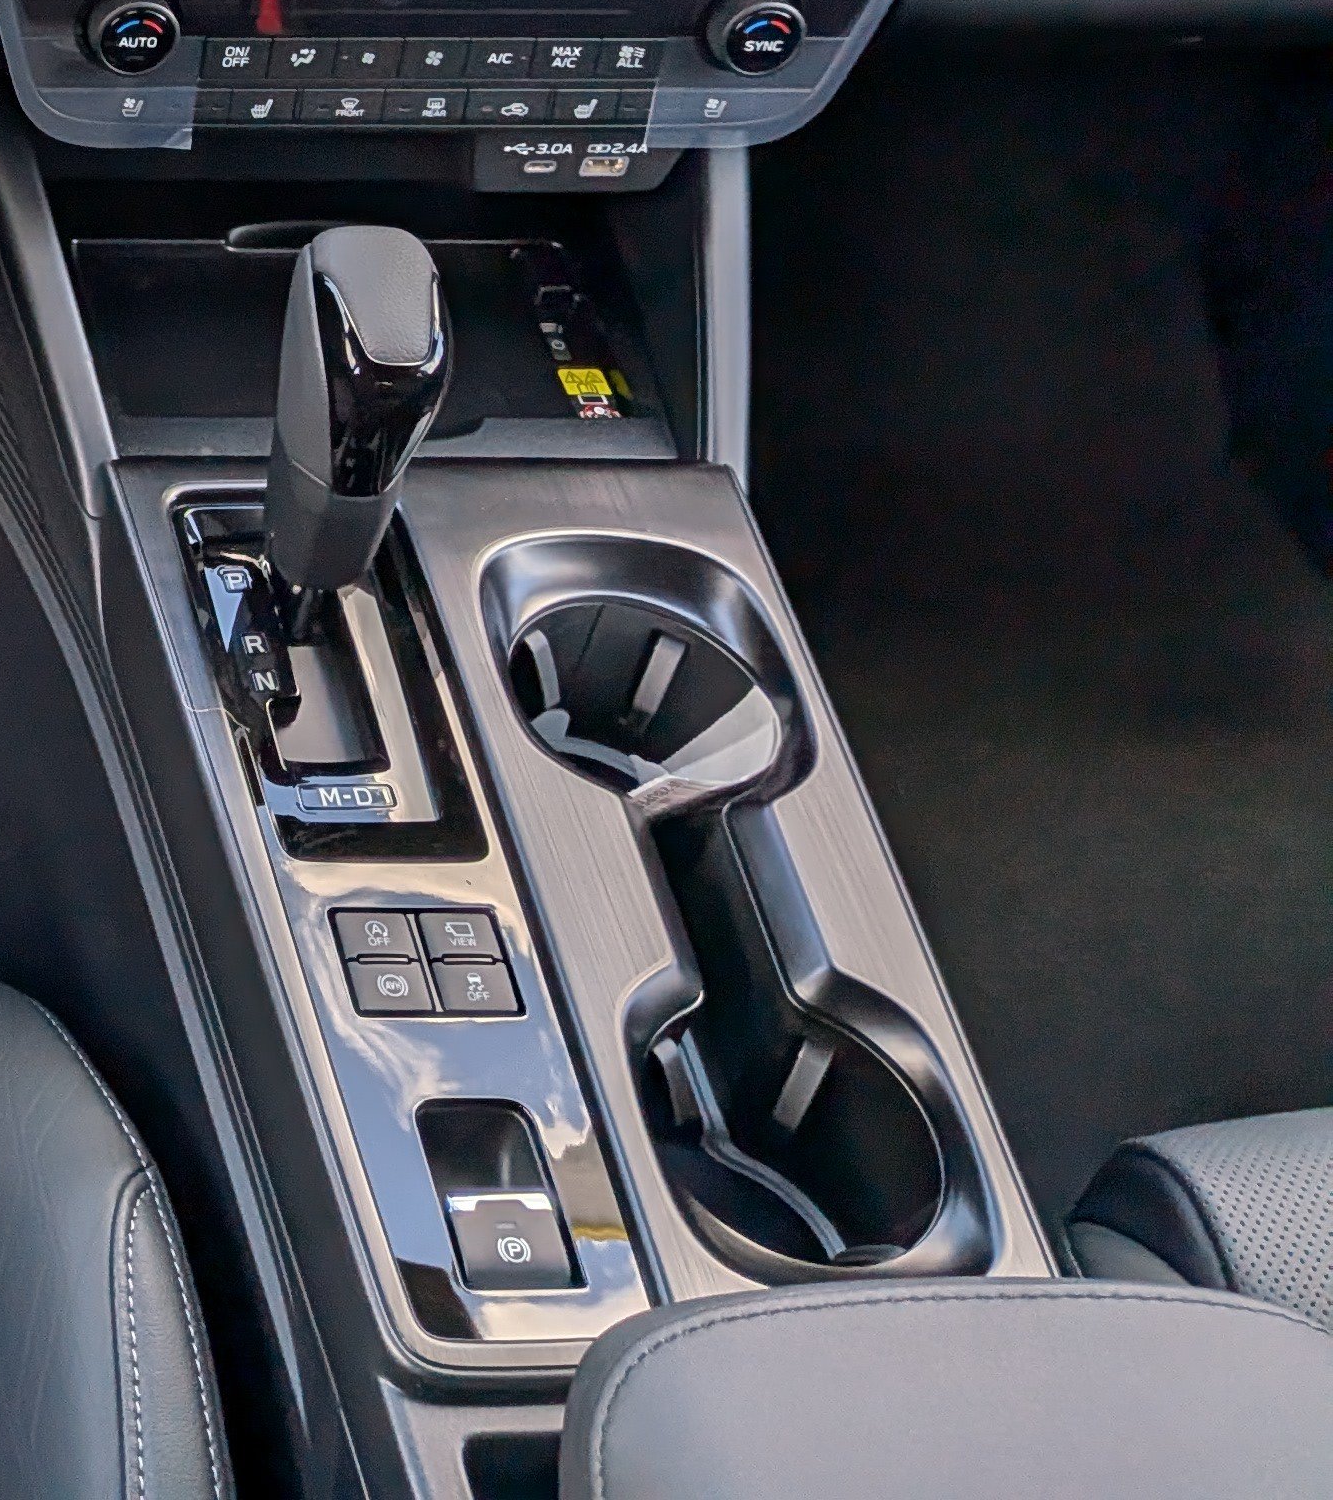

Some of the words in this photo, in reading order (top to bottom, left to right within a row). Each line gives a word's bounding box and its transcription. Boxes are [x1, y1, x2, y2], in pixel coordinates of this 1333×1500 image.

[118, 36, 158, 49] AUTO
[743, 40, 785, 53] SYNC
[225, 46, 251, 57] ON/
[551, 46, 583, 57] MAX
[222, 56, 250, 68] OFF
[486, 52, 514, 65] A/C
[551, 57, 578, 69] A/C
[616, 57, 644, 69] ALL
[335, 109, 365, 117] FRONT
[421, 109, 447, 117] REAR
[535, 143, 573, 155] 3.0A
[610, 143, 648, 155] 2.4A
[227, 572, 243, 590] P
[244, 635, 266, 654] R
[255, 671, 277, 691] N
[368, 937, 391, 947] OFF
[449, 937, 477, 948] VIEW
[467, 990, 491, 1002] OFF
